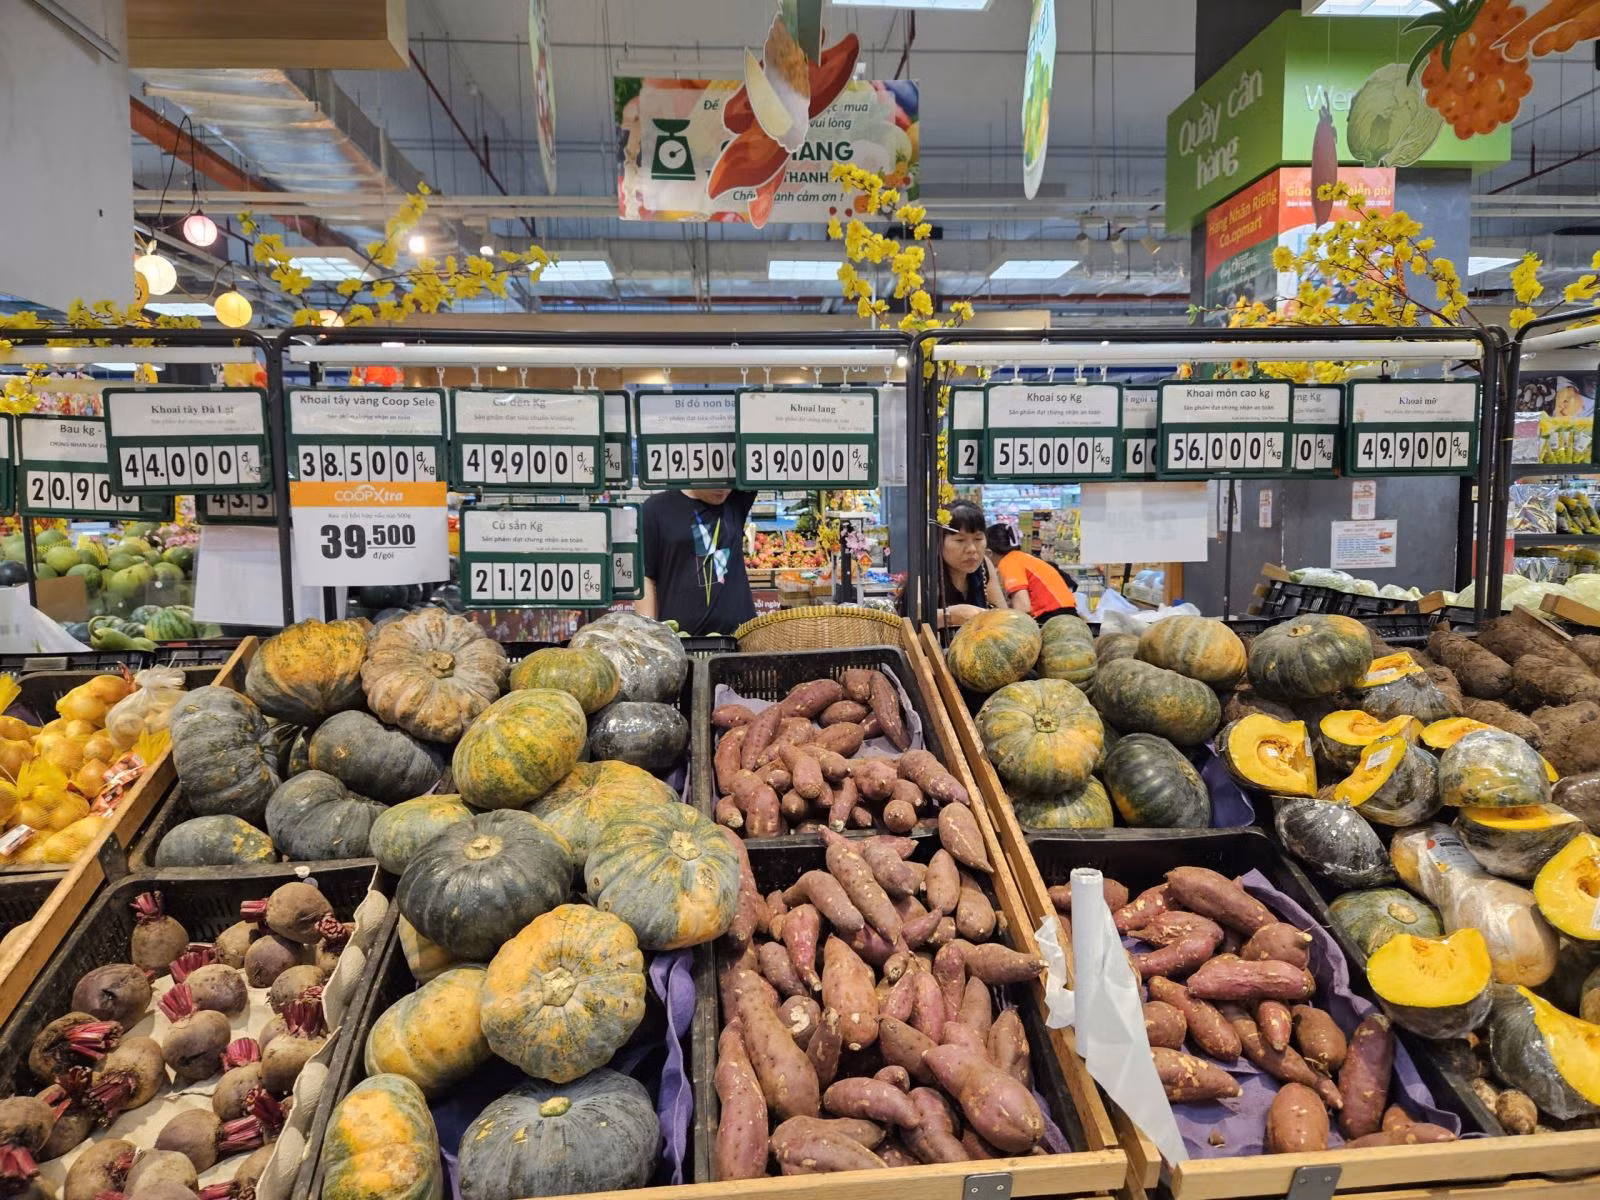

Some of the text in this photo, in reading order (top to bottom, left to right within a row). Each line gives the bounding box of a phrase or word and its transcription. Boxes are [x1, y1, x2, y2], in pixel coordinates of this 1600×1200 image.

[844, 103, 869, 112] mua
[1180, 69, 1262, 156] Quầy cân
[810, 118, 852, 130] vui lòng
[1197, 136, 1239, 191] hàng
[798, 190, 819, 202] cảm
[822, 193, 837, 202] ơn
[1286, 186, 1311, 197] Giao
[1027, 392, 1082, 403] Khoai sọ Kg
[1186, 388, 1271, 399] Khoai môn cao kg
[1310, 392, 1321, 402] Kg
[300, 395, 435, 408] Khoai tây vàng Coop Sele
[533, 398, 546, 408] Kg
[675, 399, 684, 408] Bí
[703, 400, 722, 408] non
[1399, 396, 1423, 405] Khoai
[151, 405, 180, 414] Khoai
[183, 405, 198, 415] tây
[201, 404, 215, 414] Đà
[790, 404, 836, 414] Khoai lang
[60, 424, 80, 434] Bau
[82, 424, 95, 436] kg
[999, 442, 1089, 466] 55.000
[1173, 437, 1261, 462] 56.000
[1362, 436, 1447, 460] 49.900
[751, 449, 844, 473] 39.000
[964, 444, 975, 466] 2
[125, 451, 232, 478] 44.000
[302, 451, 409, 477] 38.500
[467, 449, 568, 475] 49.900
[492, 519, 543, 532] Củ sắn Kg
[320, 524, 416, 559] 39.500
[373, 552, 394, 560] đ/gói
[615, 558, 632, 578] đ/kg
[476, 569, 574, 592] 21.200
